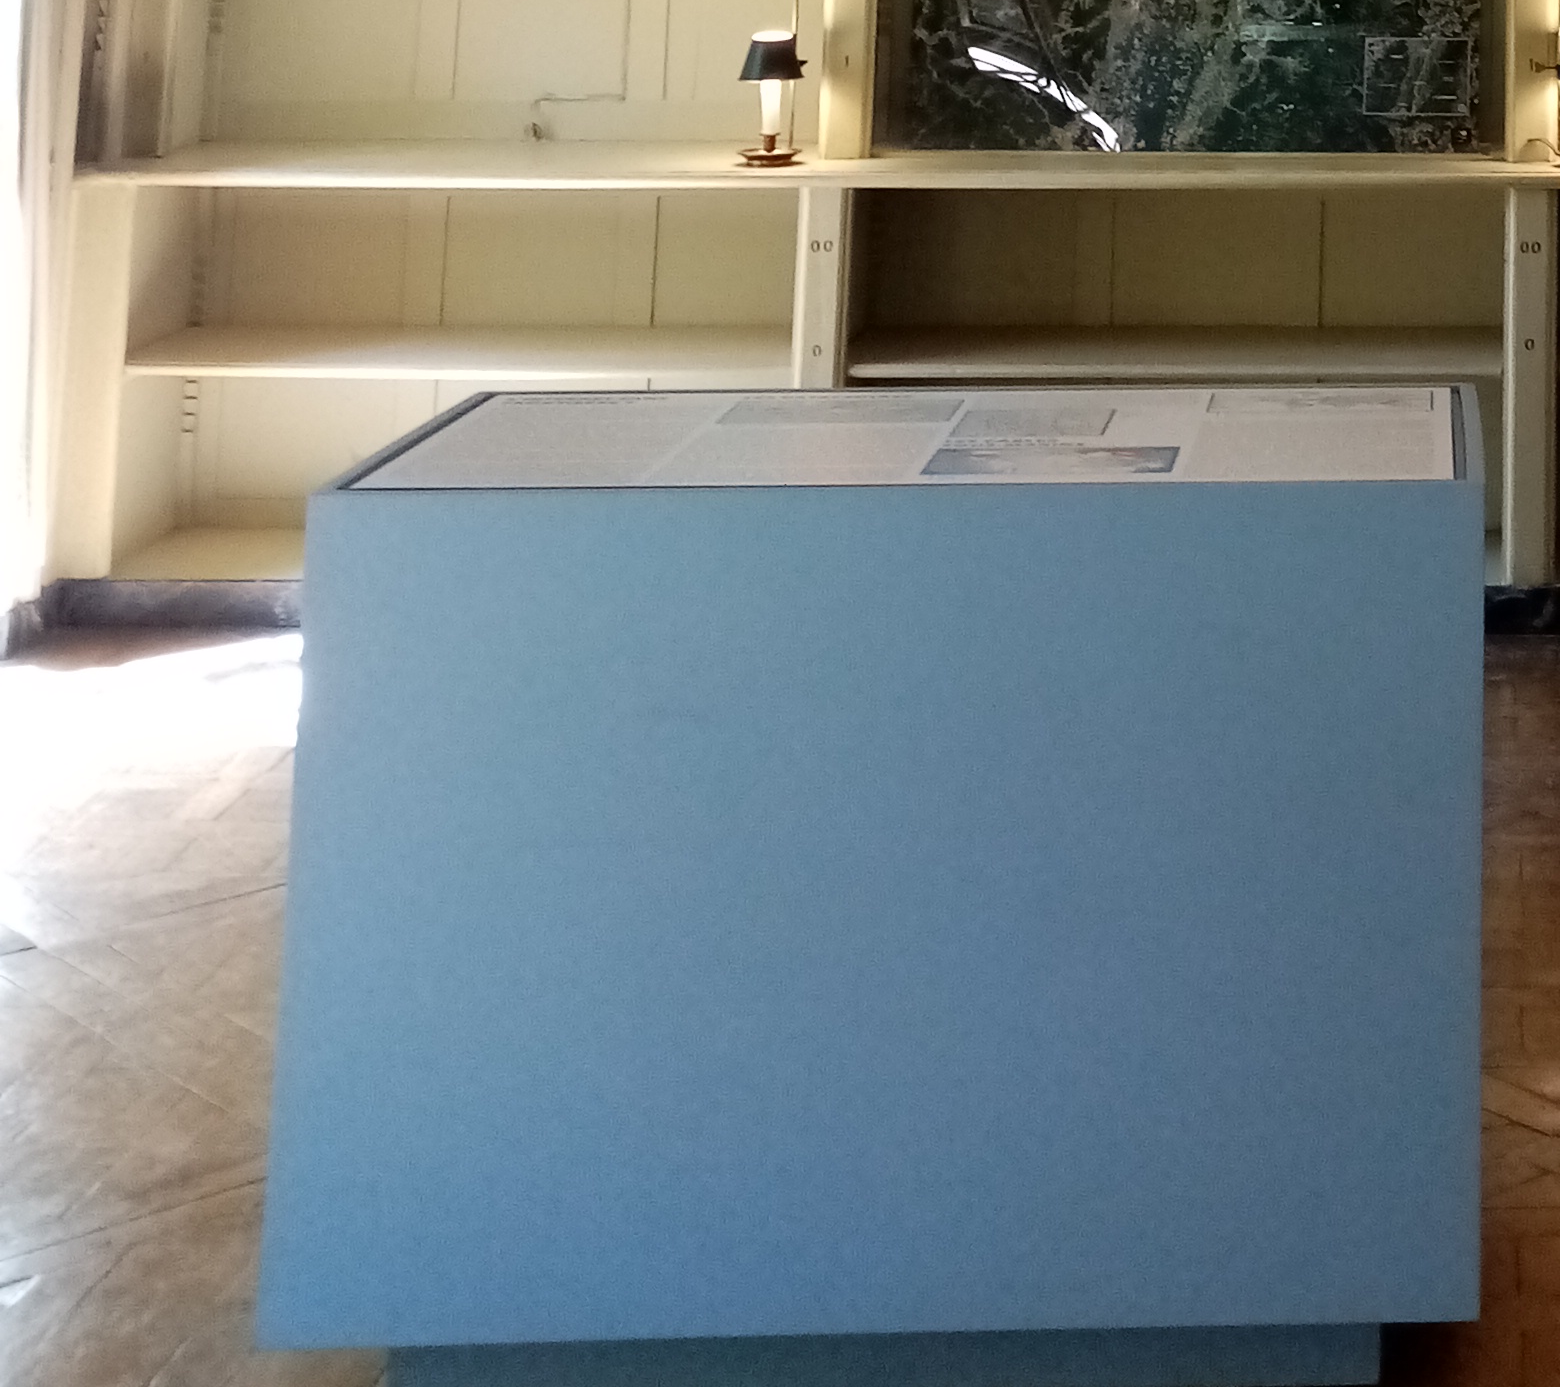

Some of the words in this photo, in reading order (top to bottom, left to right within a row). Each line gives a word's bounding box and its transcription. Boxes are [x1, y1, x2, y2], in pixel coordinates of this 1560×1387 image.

[810, 240, 834, 253] 00
[1519, 241, 1542, 254] 00
[1524, 338, 1535, 351] 0
